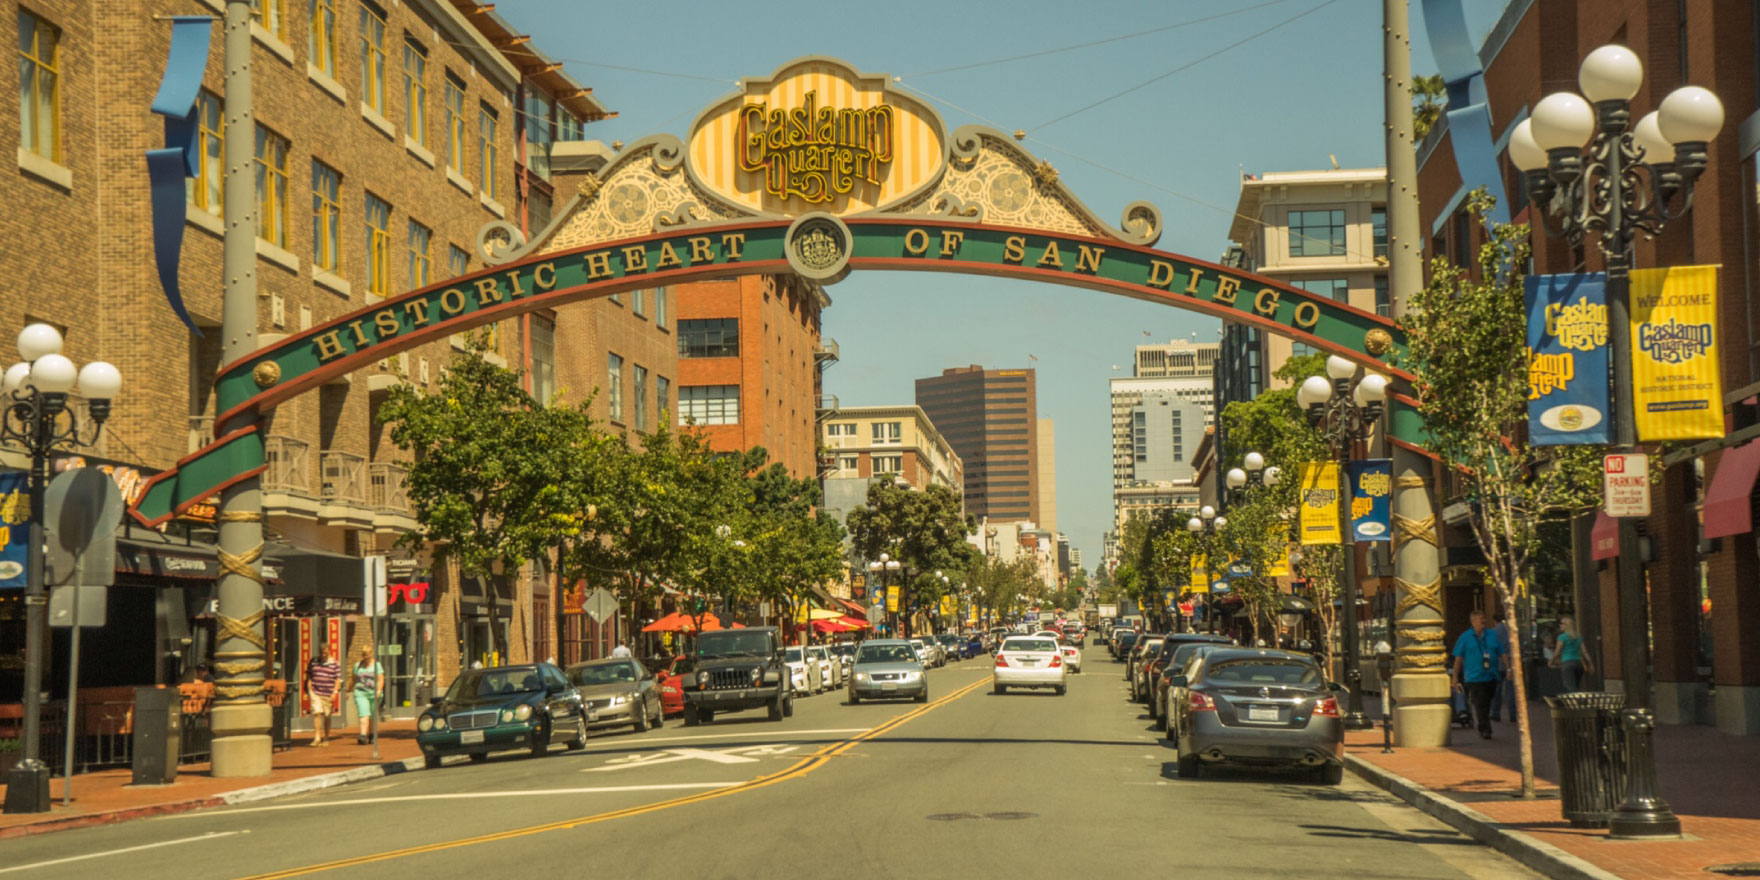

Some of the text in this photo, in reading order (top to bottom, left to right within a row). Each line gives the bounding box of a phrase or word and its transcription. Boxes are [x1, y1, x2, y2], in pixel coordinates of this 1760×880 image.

[739, 90, 893, 185] Gaslamp
[766, 145, 872, 203] Quarter
[313, 264, 556, 360] HISTORIC
[584, 233, 745, 279] HEART
[905, 228, 963, 255] OF
[1004, 236, 1105, 272] SAN
[1147, 260, 1320, 327] DIEGO
[1637, 294, 1712, 308] WELCOME
[1545, 296, 1608, 336] Gaslam
[1639, 318, 1712, 355] Gaslamp
[1652, 338, 1701, 364] Quarter
[1656, 375, 1697, 383] NATIONAL
[1608, 457, 1623, 471] NO
[1609, 476, 1645, 488] PARKING
